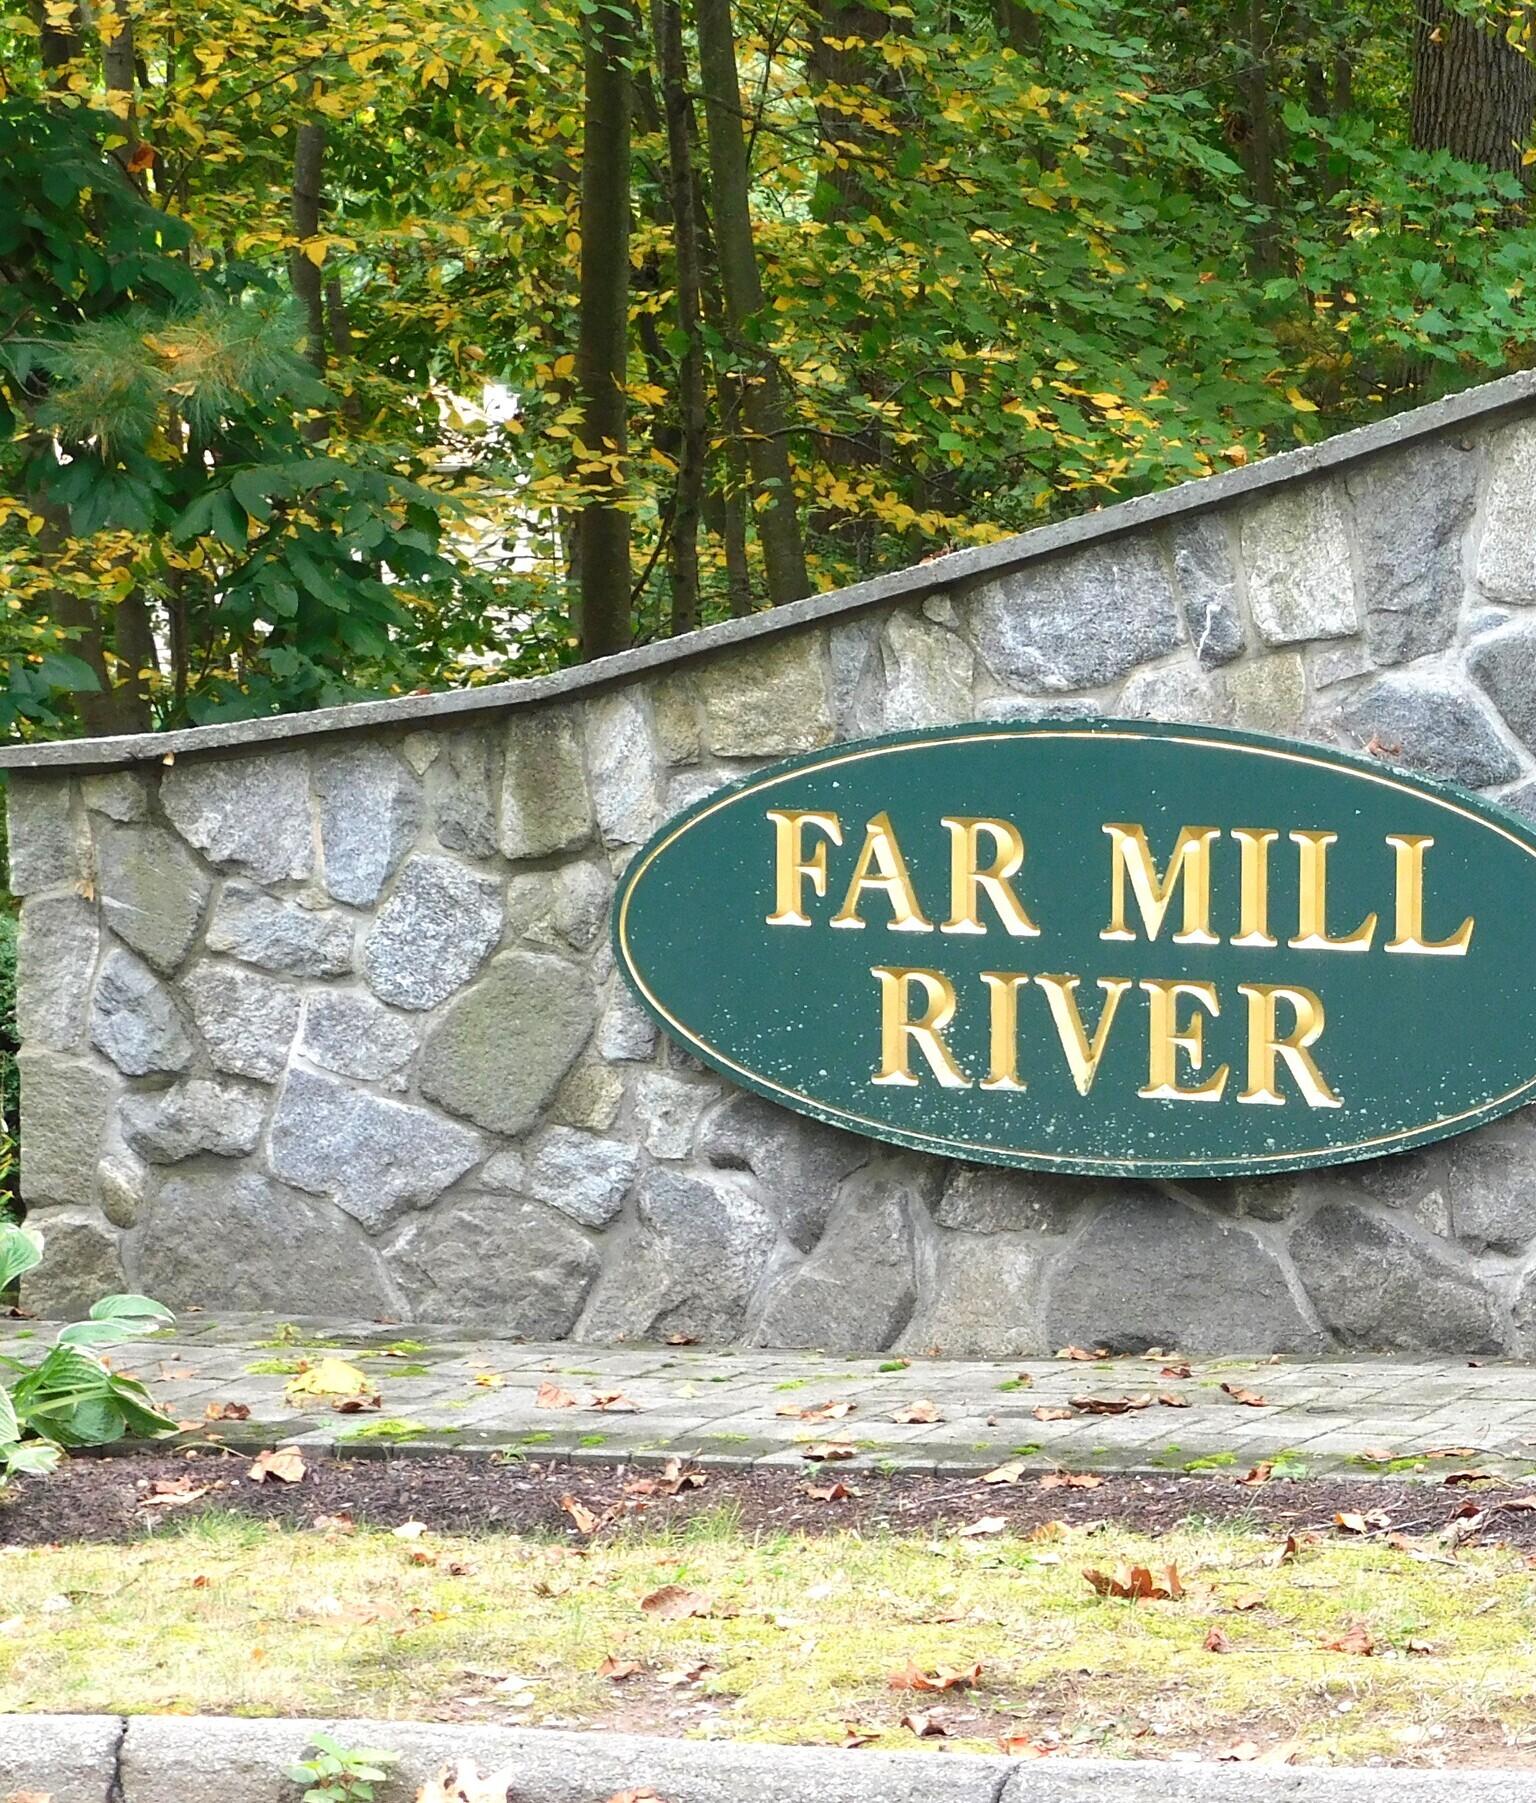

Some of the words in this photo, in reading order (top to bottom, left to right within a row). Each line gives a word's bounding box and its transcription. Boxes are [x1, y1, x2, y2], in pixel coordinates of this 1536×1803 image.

[766, 809, 1041, 938] FAR
[1100, 821, 1475, 956] MILL
[871, 966, 1343, 1108] RIVER
